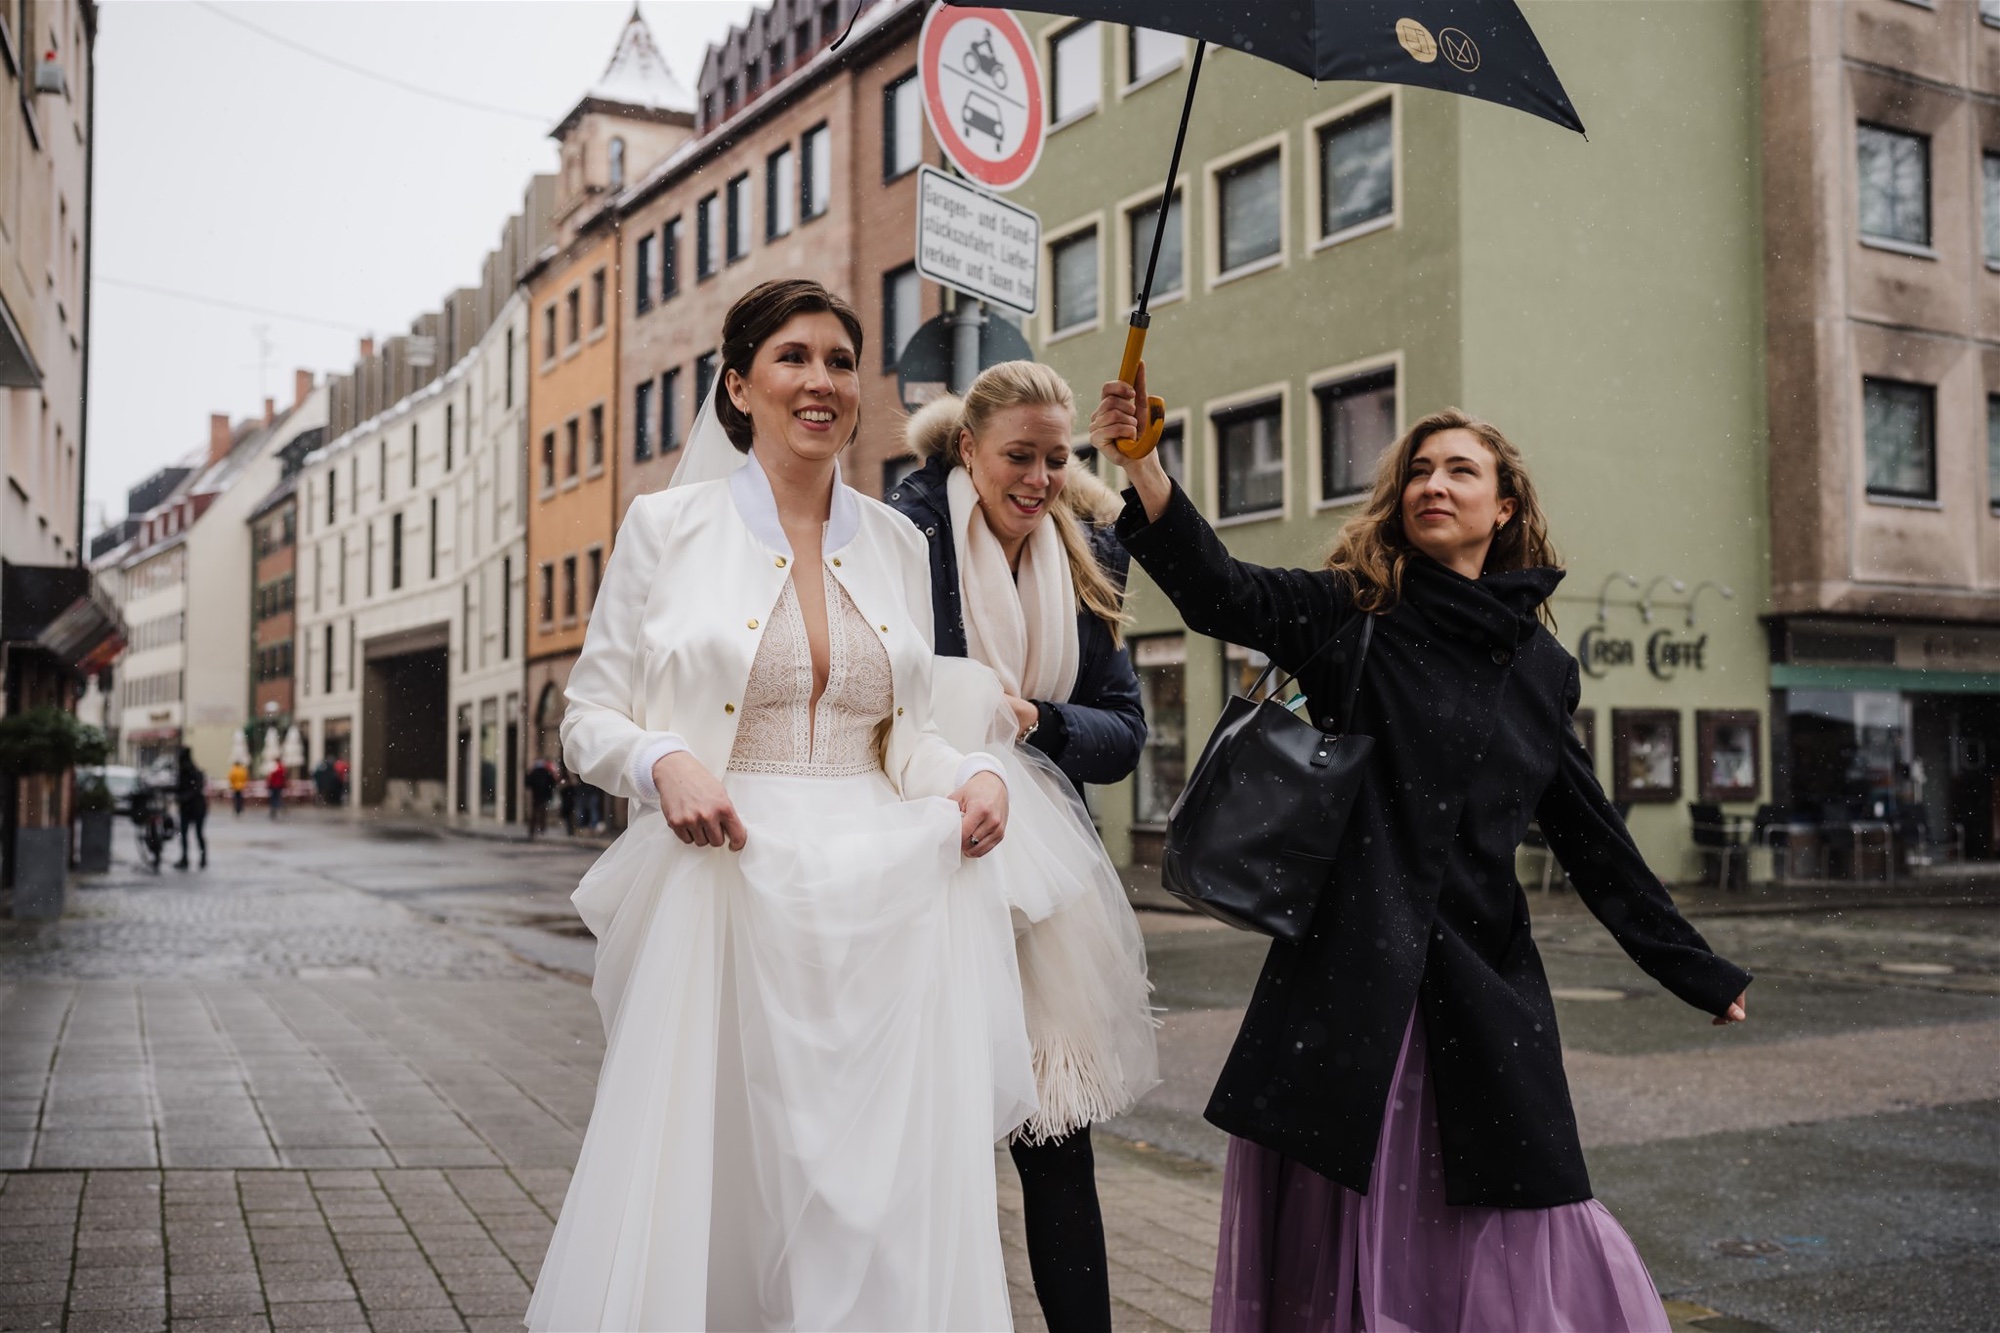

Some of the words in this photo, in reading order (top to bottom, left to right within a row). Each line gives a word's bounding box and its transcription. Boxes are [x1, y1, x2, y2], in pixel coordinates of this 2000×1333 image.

[924, 184, 974, 218] Garagen-
[979, 212, 998, 231] und
[1001, 216, 1034, 245] Grund-
[924, 245, 962, 272] verkehr
[966, 262, 983, 280] und
